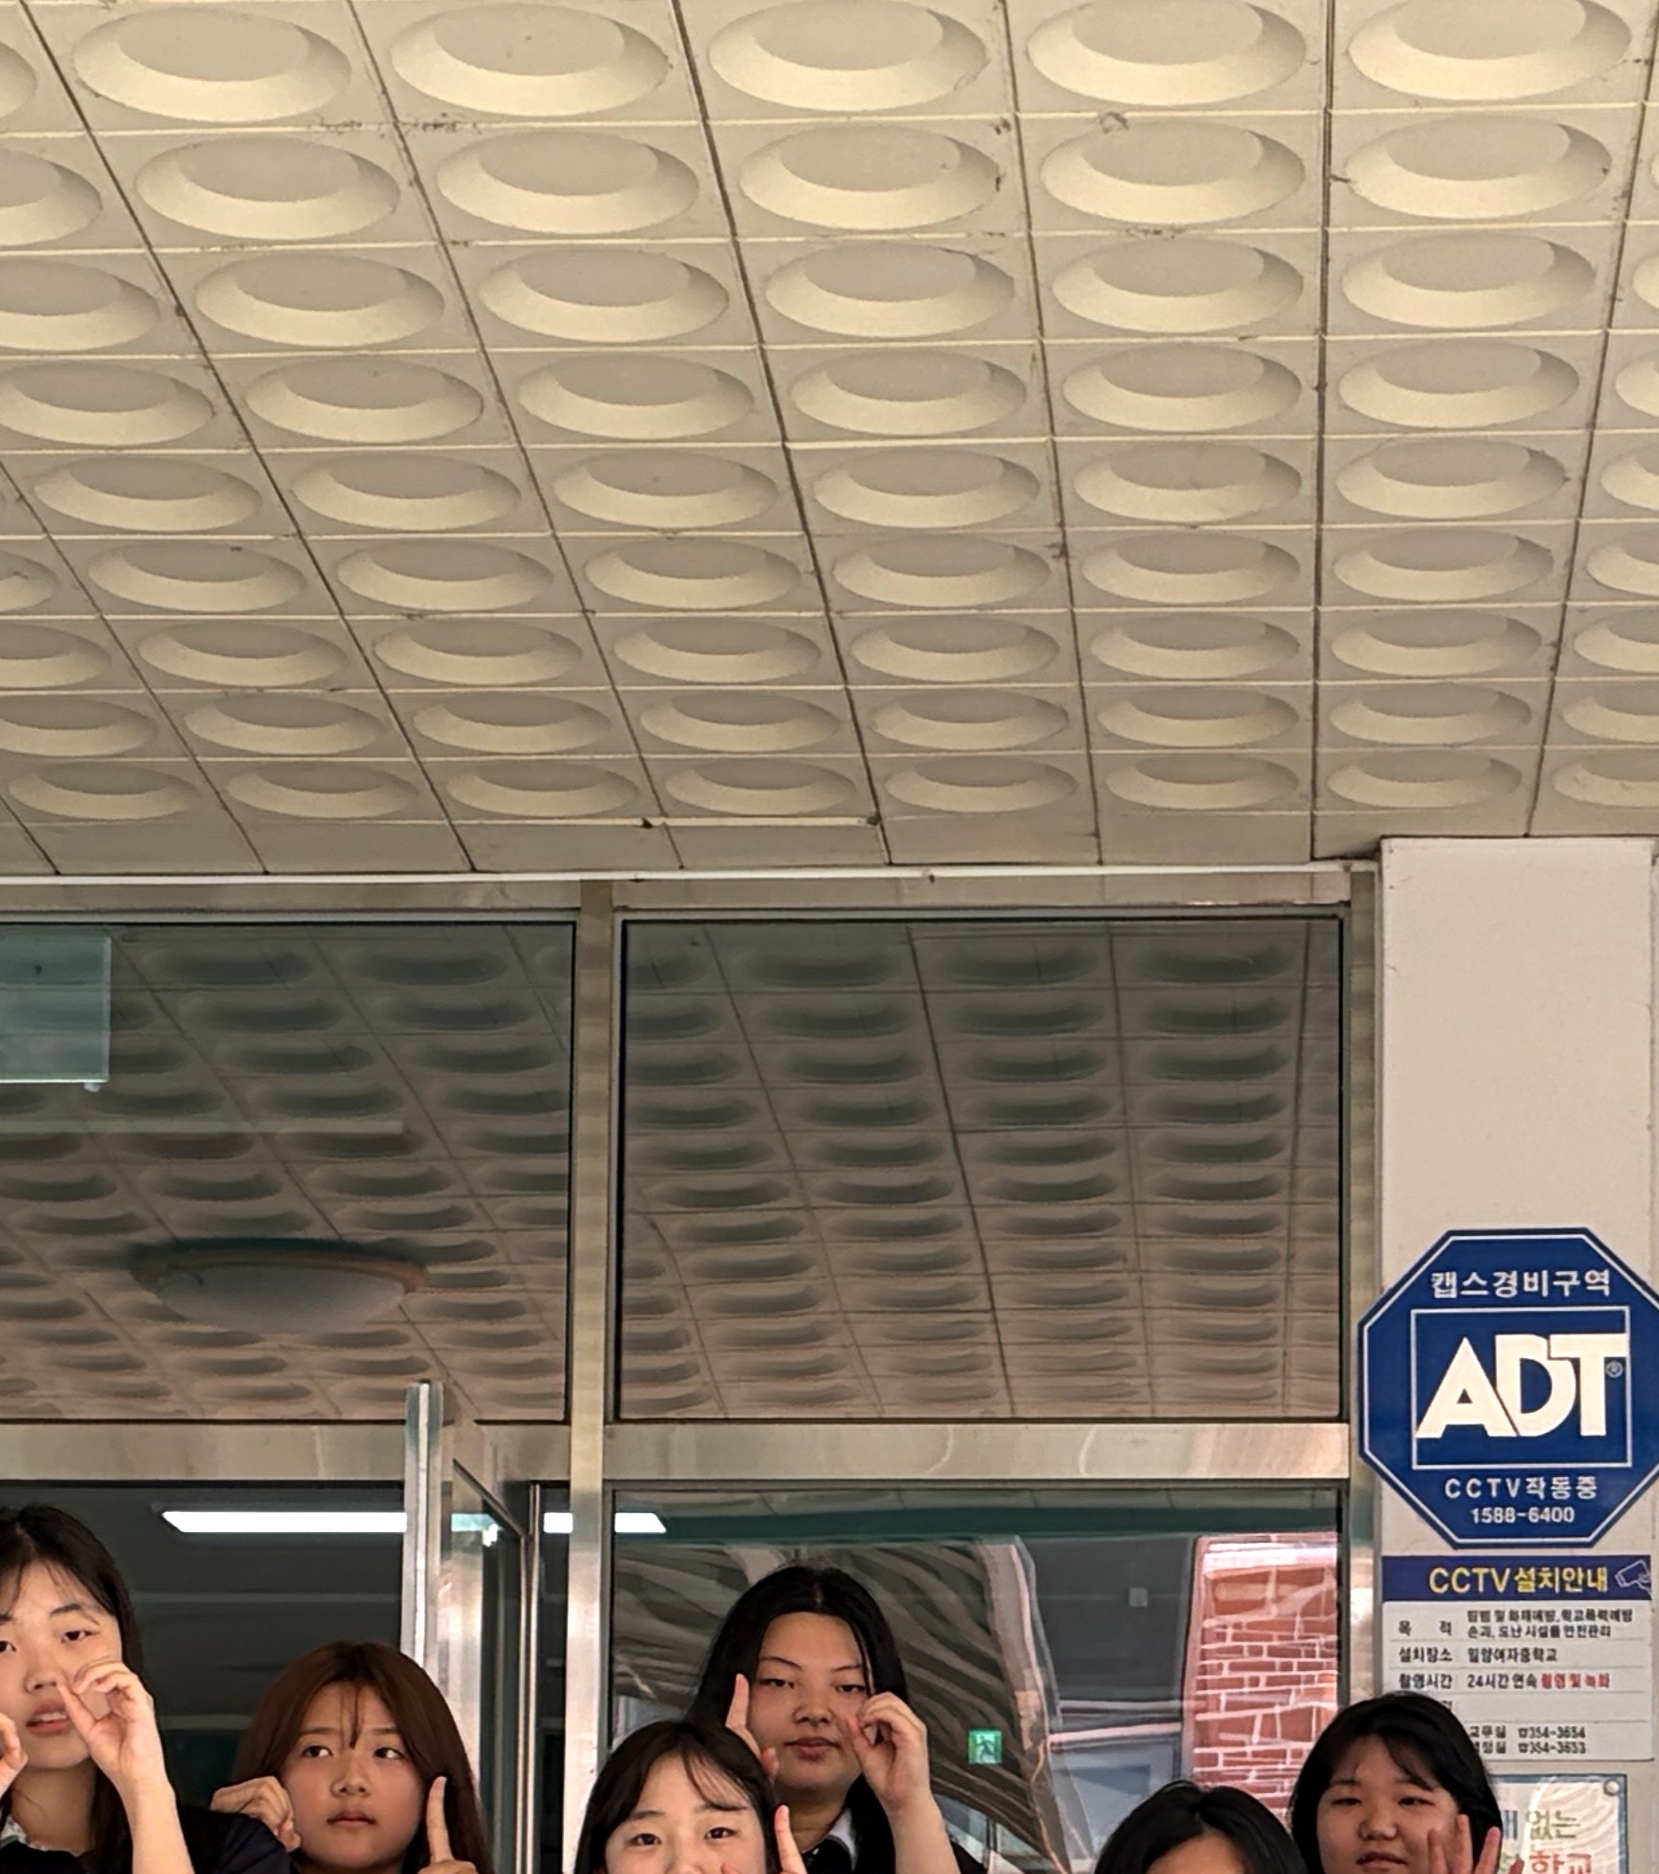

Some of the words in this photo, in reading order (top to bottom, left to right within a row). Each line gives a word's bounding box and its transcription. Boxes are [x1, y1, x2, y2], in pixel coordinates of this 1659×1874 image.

[1431, 1270, 1611, 1298] 캡스경비구역
[1416, 1333, 1628, 1438] ADT
[1471, 1507, 1575, 1525] 1588-6400
[1399, 1646, 1453, 1663] 설치장소
[1467, 1673, 1509, 1689] 24시간
